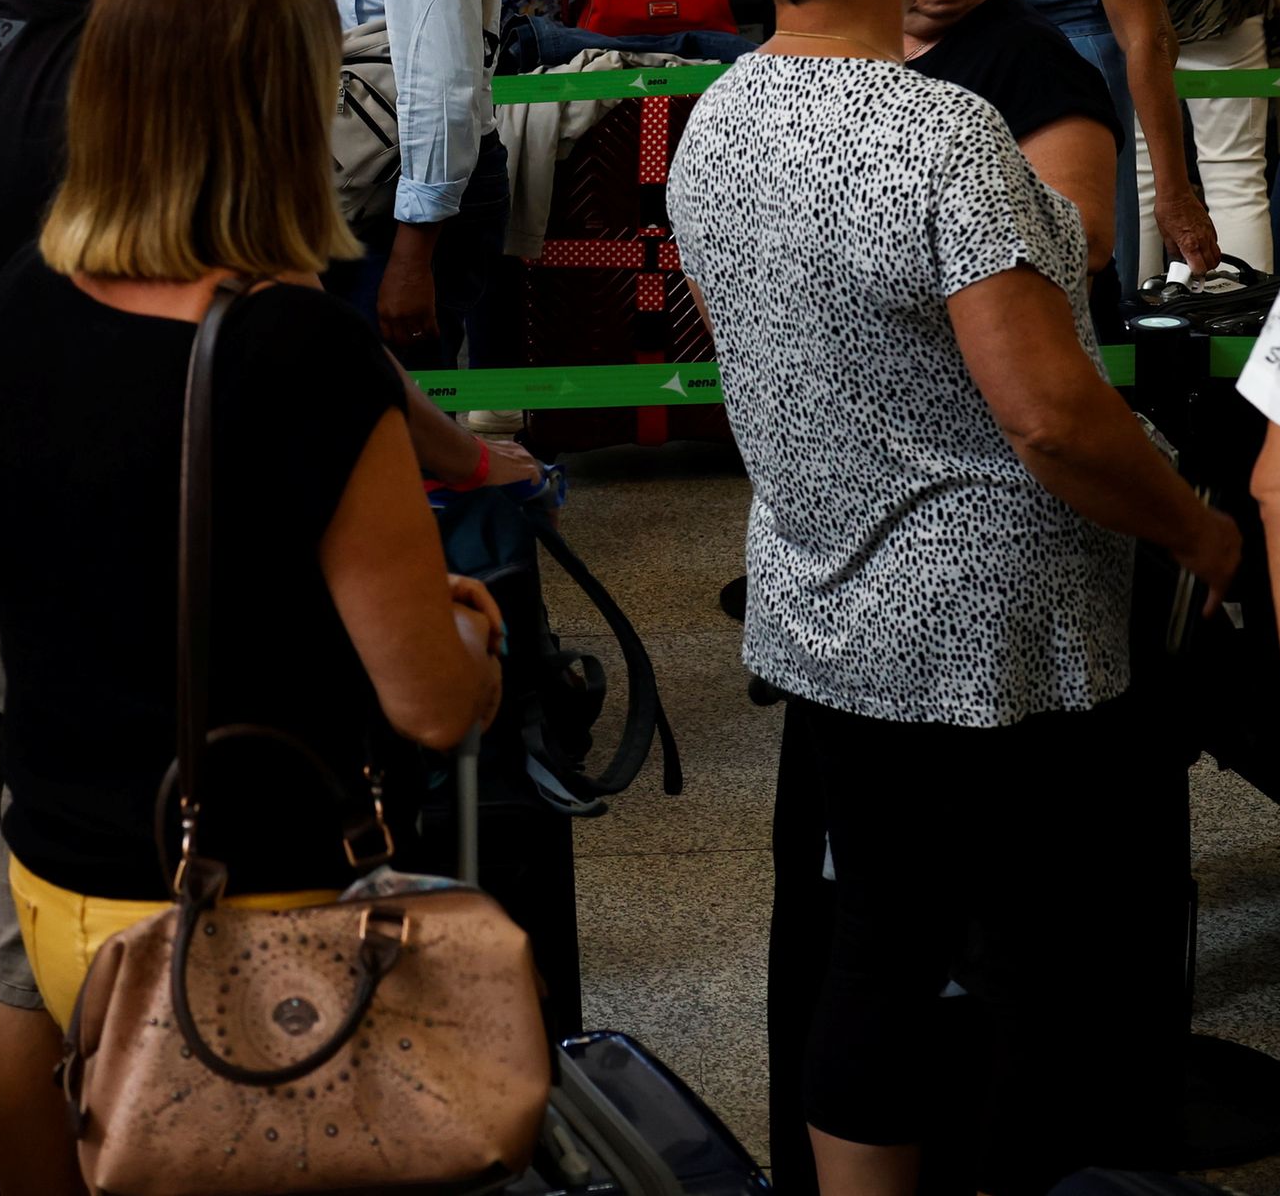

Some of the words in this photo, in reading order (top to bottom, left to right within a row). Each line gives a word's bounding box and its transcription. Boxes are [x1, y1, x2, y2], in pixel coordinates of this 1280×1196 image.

[647, 78, 668, 86] aena
[687, 378, 717, 388] aena
[427, 387, 457, 396] aena
